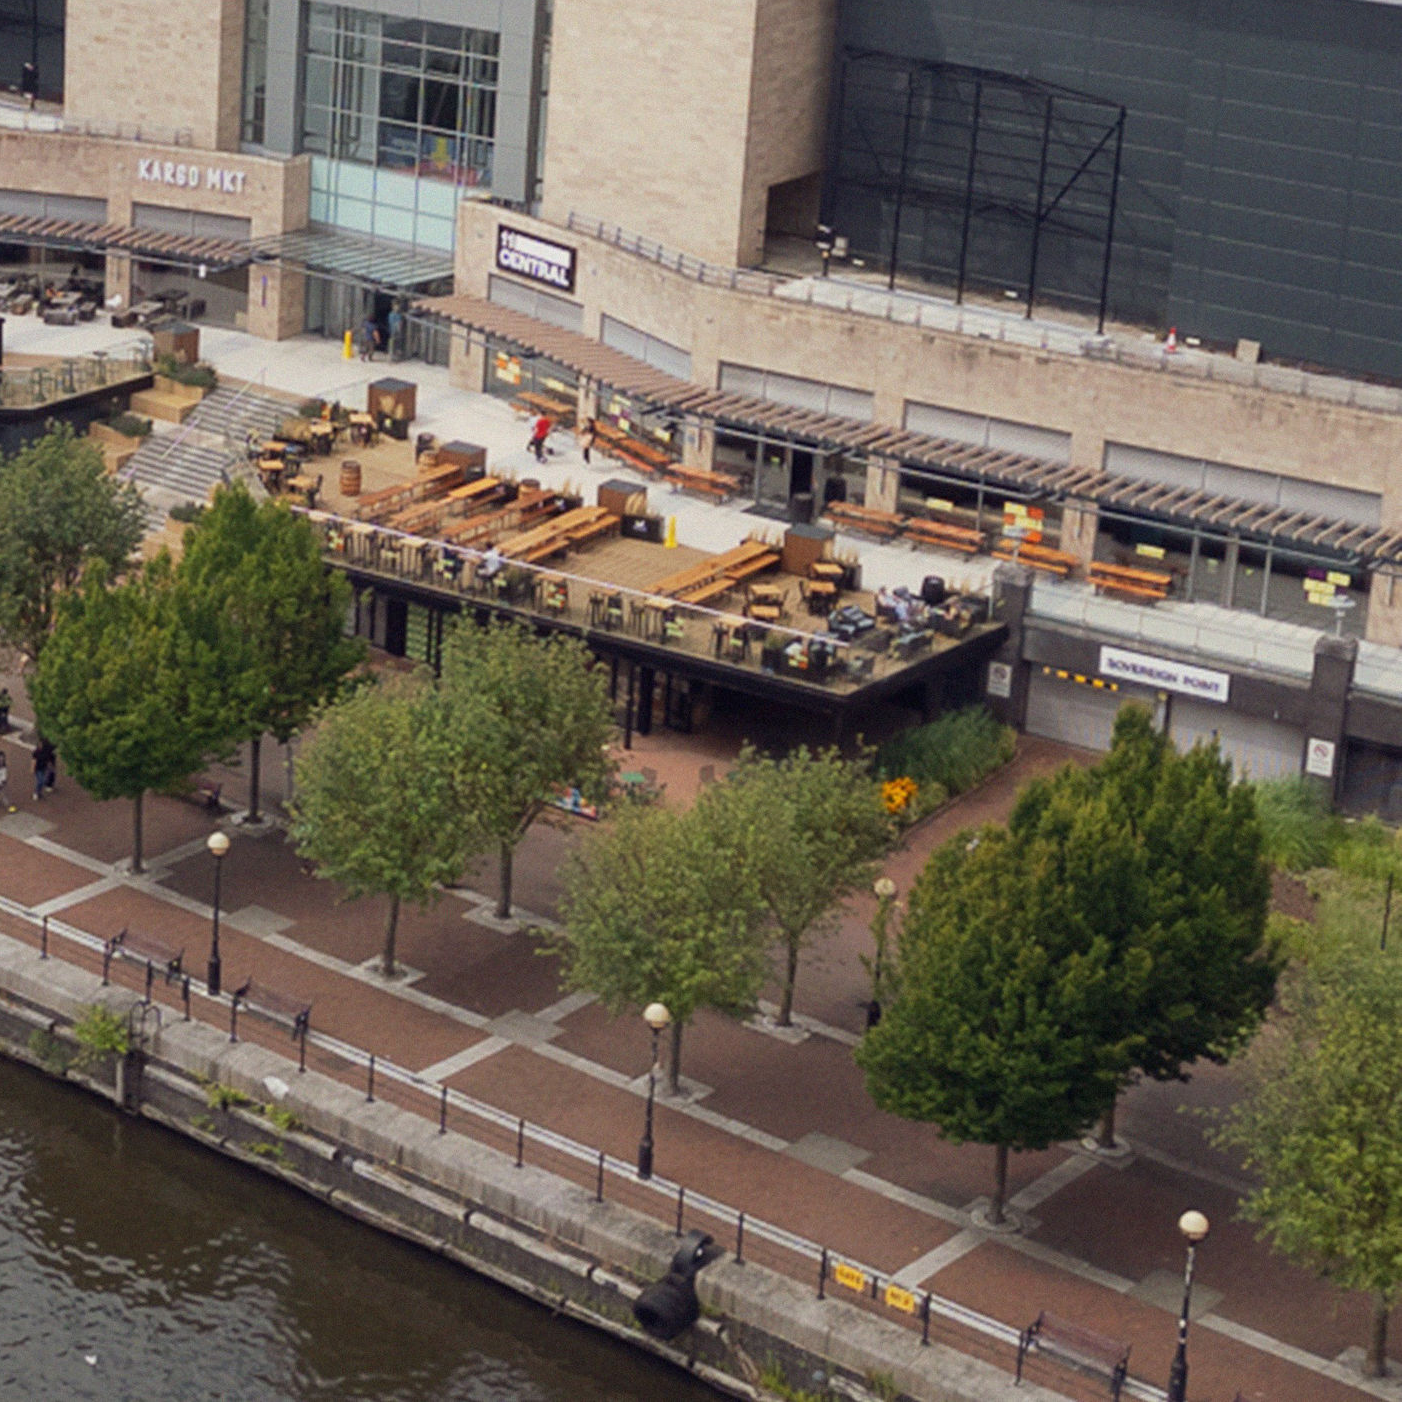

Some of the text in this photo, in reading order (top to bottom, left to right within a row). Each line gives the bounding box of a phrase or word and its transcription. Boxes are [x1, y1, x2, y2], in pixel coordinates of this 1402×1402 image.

[139, 159, 245, 193] KARGO MKT
[499, 248, 570, 287] CENTRAL
[1107, 658, 1219, 693] SOVEREIGN POINT
